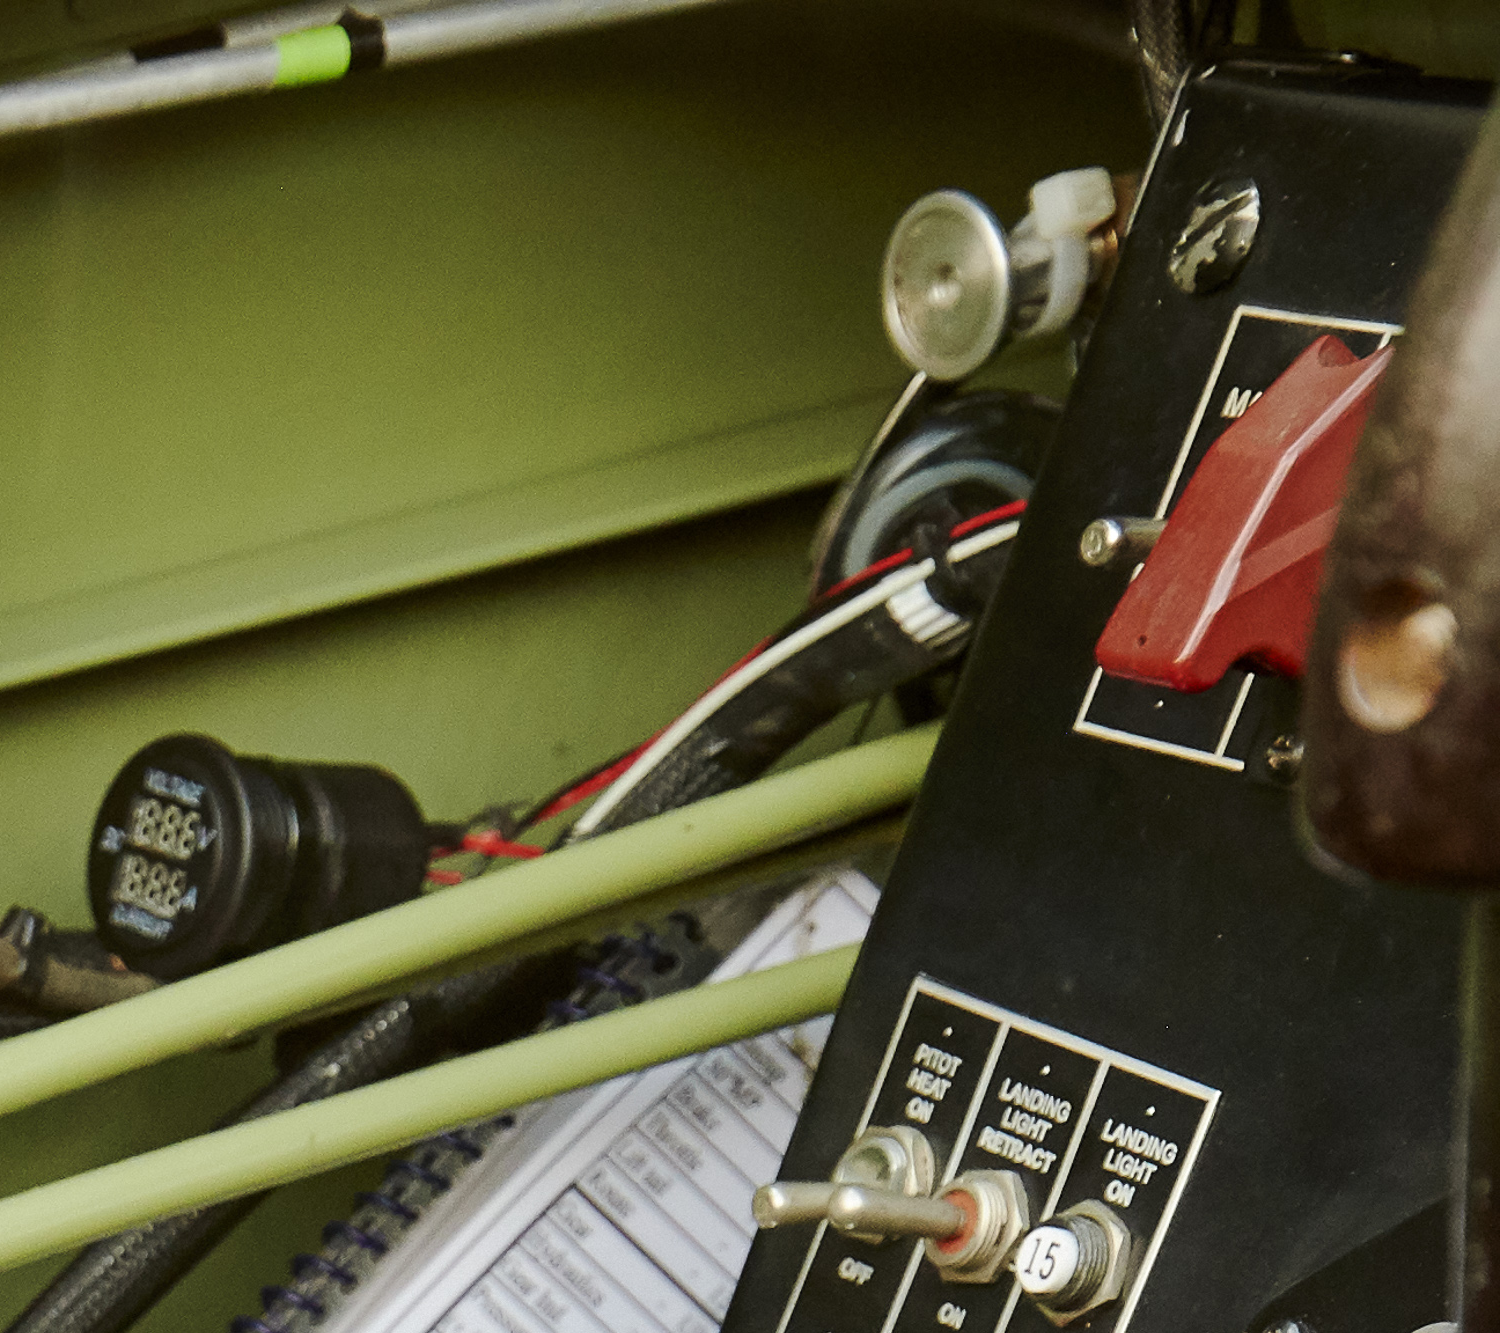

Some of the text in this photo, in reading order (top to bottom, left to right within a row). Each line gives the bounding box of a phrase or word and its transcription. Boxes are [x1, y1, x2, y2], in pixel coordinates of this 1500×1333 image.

[914, 1043, 962, 1079] PITOT
[908, 1070, 952, 1103] HEAT
[999, 1077, 1072, 1125] LANDING
[905, 1099, 934, 1125] ON
[1000, 1105, 1052, 1142] LIGHT
[978, 1127, 1058, 1176] RETRACT
[1102, 1119, 1179, 1167] LANDING
[1104, 1148, 1158, 1186] LIGHT
[1105, 1178, 1136, 1208] ON
[838, 1256, 873, 1287] OFF
[1024, 1236, 1062, 1281] 15
[936, 1300, 967, 1331] ON
